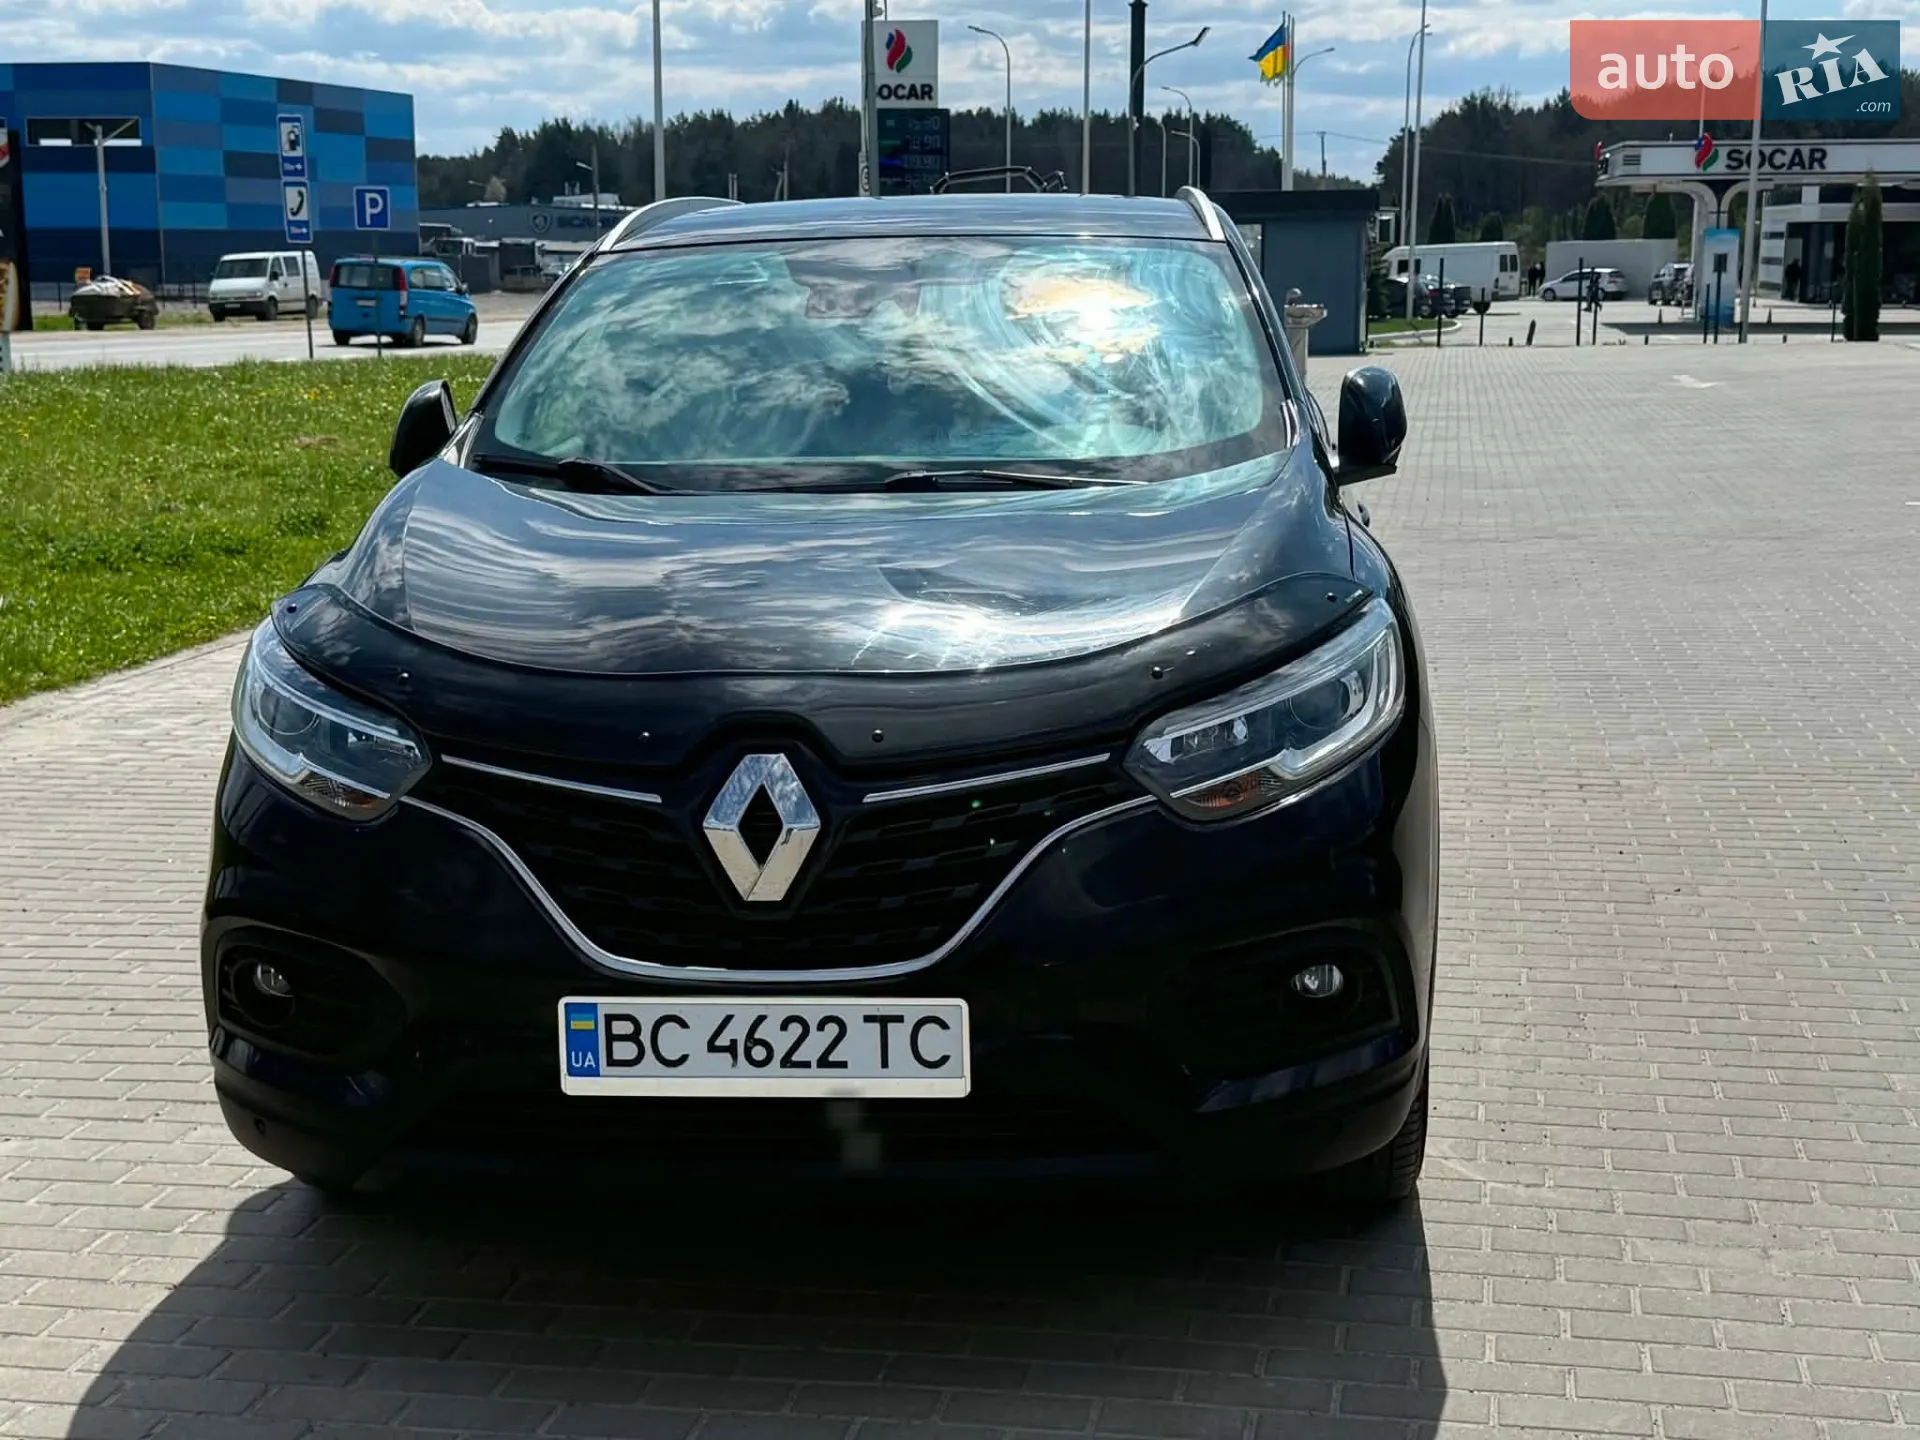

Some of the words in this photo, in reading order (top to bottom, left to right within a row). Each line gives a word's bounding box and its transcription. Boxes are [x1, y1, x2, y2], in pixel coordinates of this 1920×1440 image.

[876, 83, 933, 100] OCAR
[1725, 148, 1828, 170] SOCAR
[364, 192, 384, 226] P
[604, 1013, 690, 1068] BC
[706, 1014, 849, 1069] 4622
[863, 1014, 951, 1069] TC
[571, 1051, 596, 1068] UA
